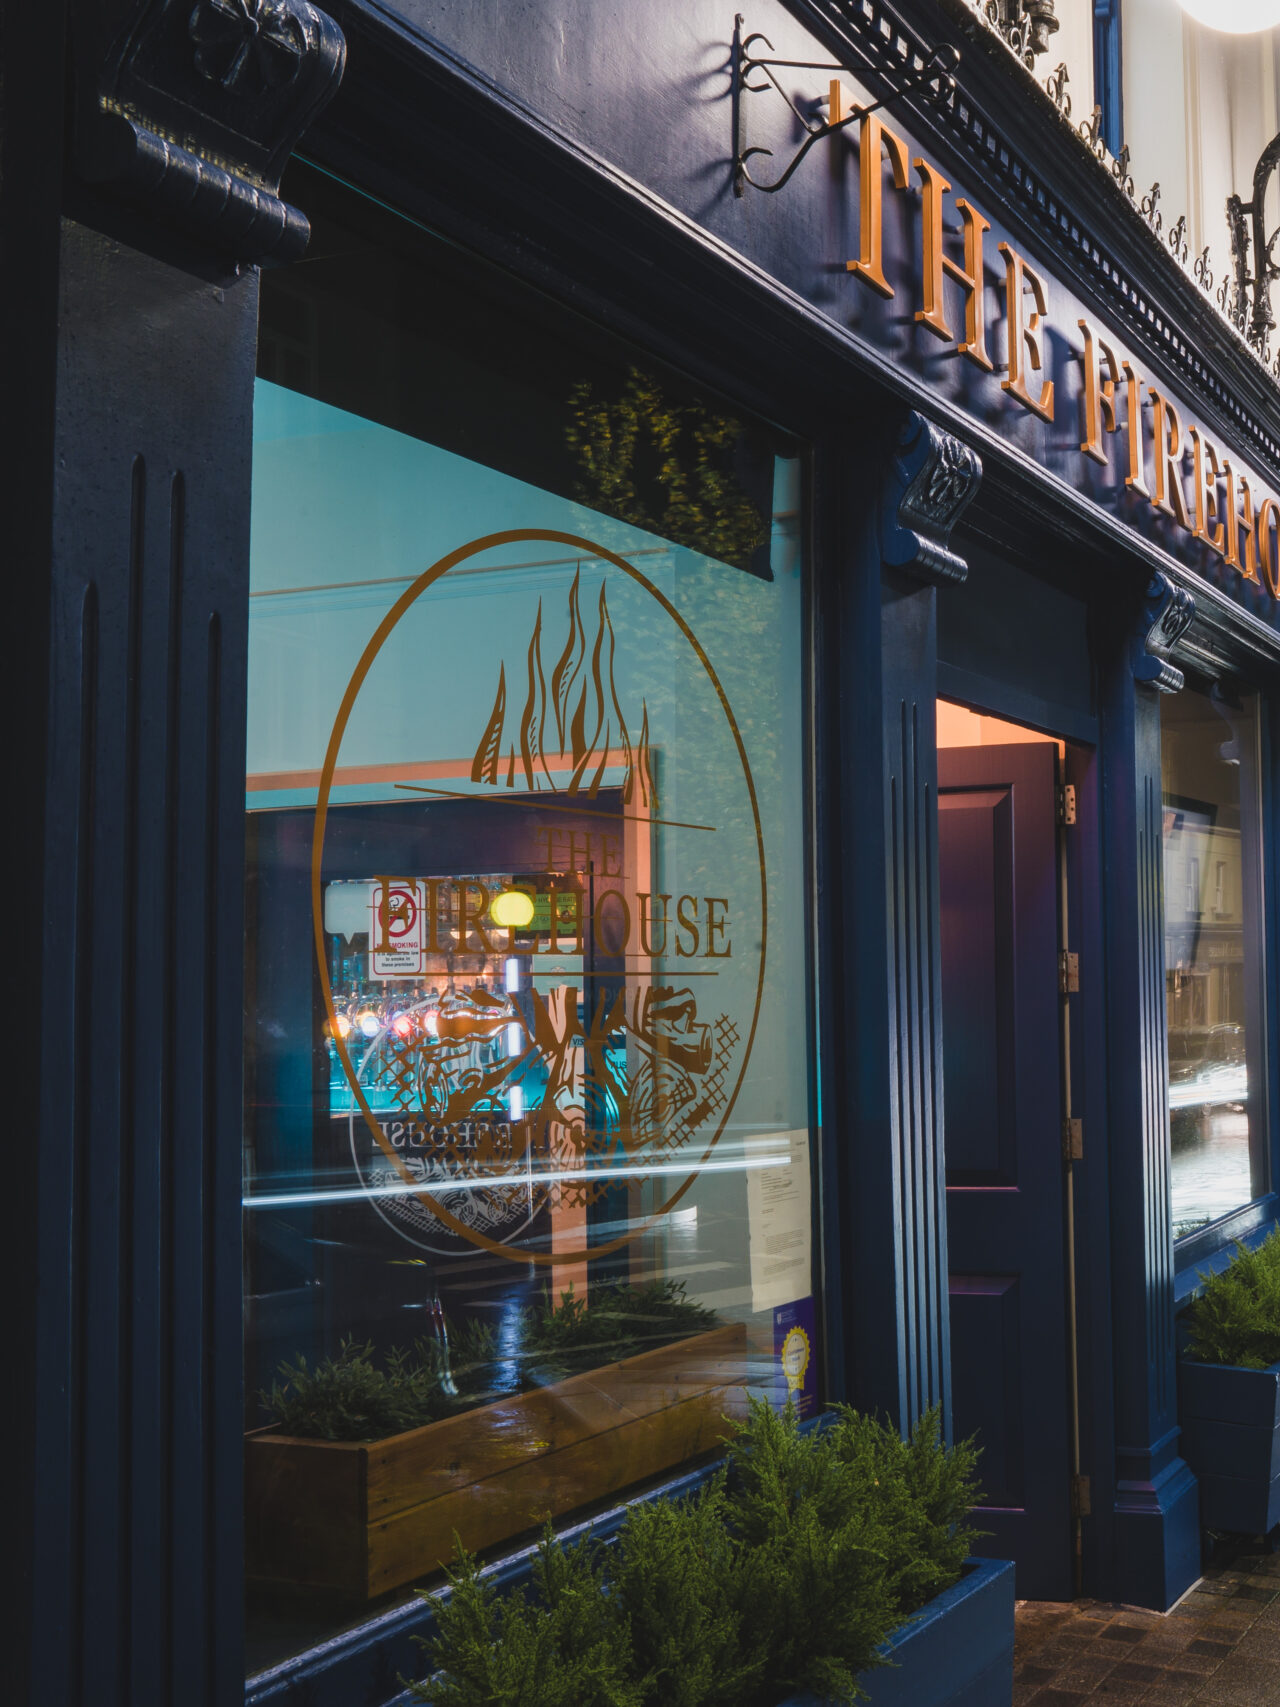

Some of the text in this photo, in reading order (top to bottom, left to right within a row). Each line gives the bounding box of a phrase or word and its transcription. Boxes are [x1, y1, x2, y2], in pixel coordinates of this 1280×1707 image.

[829, 79, 1054, 423] THE
[535, 826, 622, 878] THE
[372, 875, 732, 958] FIREHOUSE
